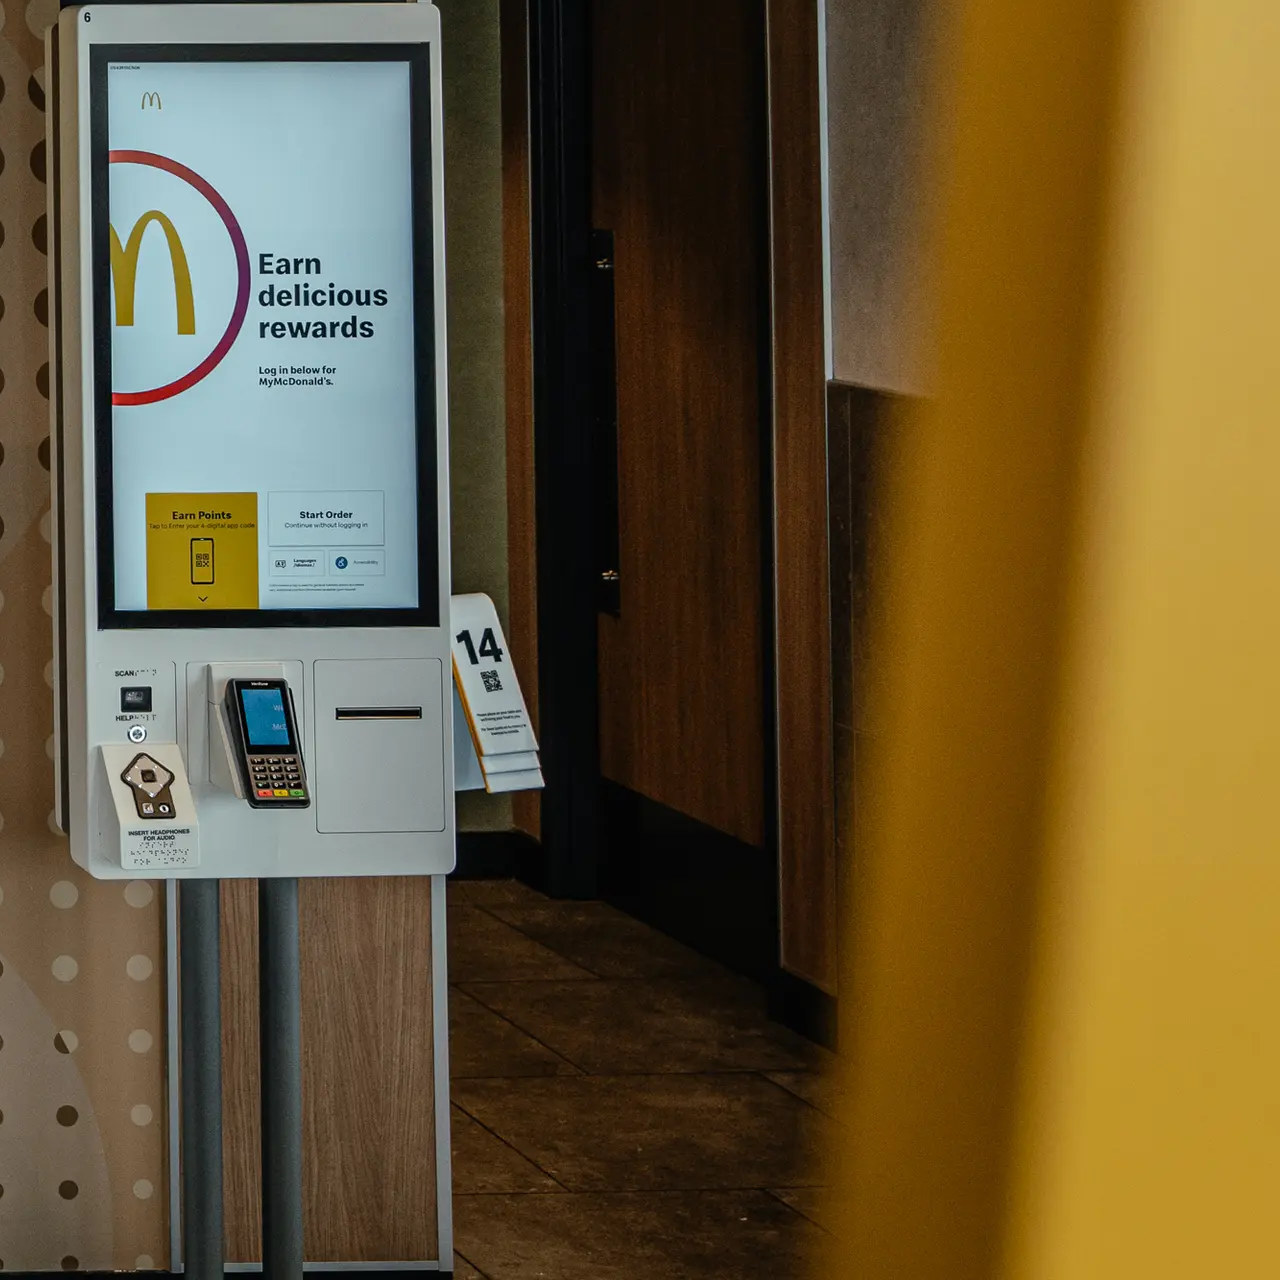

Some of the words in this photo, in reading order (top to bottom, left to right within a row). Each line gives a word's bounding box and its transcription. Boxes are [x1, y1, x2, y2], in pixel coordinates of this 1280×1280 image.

[84, 12, 91, 22] 6
[259, 253, 321, 274] Earn
[258, 283, 388, 307] delicious
[260, 316, 374, 339] rewards
[259, 367, 276, 376] Log
[279, 366, 288, 374] in
[322, 366, 336, 374] for
[259, 377, 333, 388] MyMcDonald's.
[172, 511, 195, 520] Earn
[198, 511, 232, 520] Points
[456, 628, 503, 665] 14
